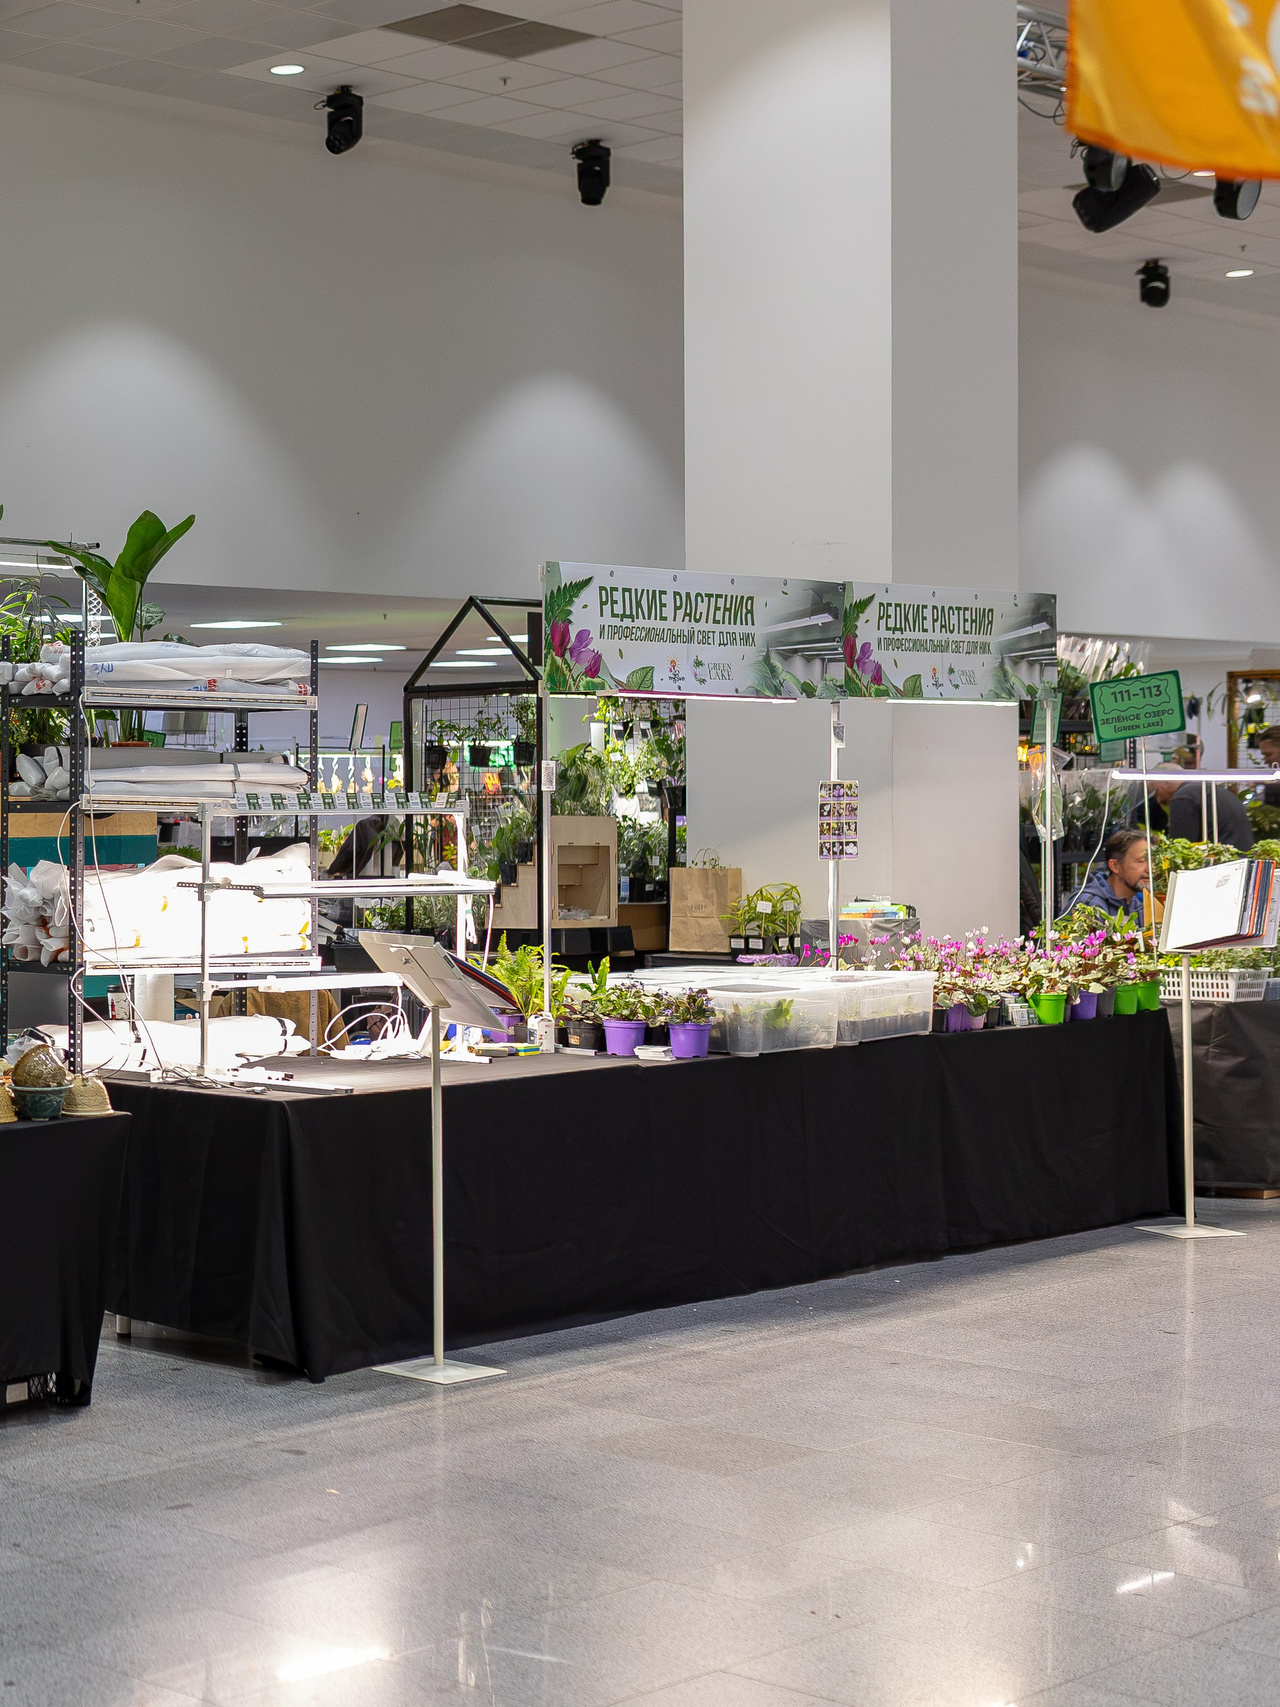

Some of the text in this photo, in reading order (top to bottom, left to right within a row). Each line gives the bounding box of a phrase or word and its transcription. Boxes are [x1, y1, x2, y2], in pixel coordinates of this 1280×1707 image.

[598, 585, 756, 626] РЕДКИЕ РАСТЕНИЯ
[877, 602, 994, 636] РЕДКИЕ РАСТЕНИЯ
[599, 624, 756, 647] И ПРОФЕССИОНАЛЬНЫЙ СВЕТ ДЛЯ НИХ
[877, 637, 992, 655] И ПРОФЕССИОНАЛЬНЫЙ СВЕТ ДЛЯ НИХ
[708, 662, 732, 673] GREEN
[708, 669, 734, 682] LAKE
[1110, 684, 1163, 704] 111-113
[1100, 708, 1175, 726] ЗЕЛЁНОЕ ОЗЕРО
[1114, 718, 1163, 734] (GREEN LAKE)
